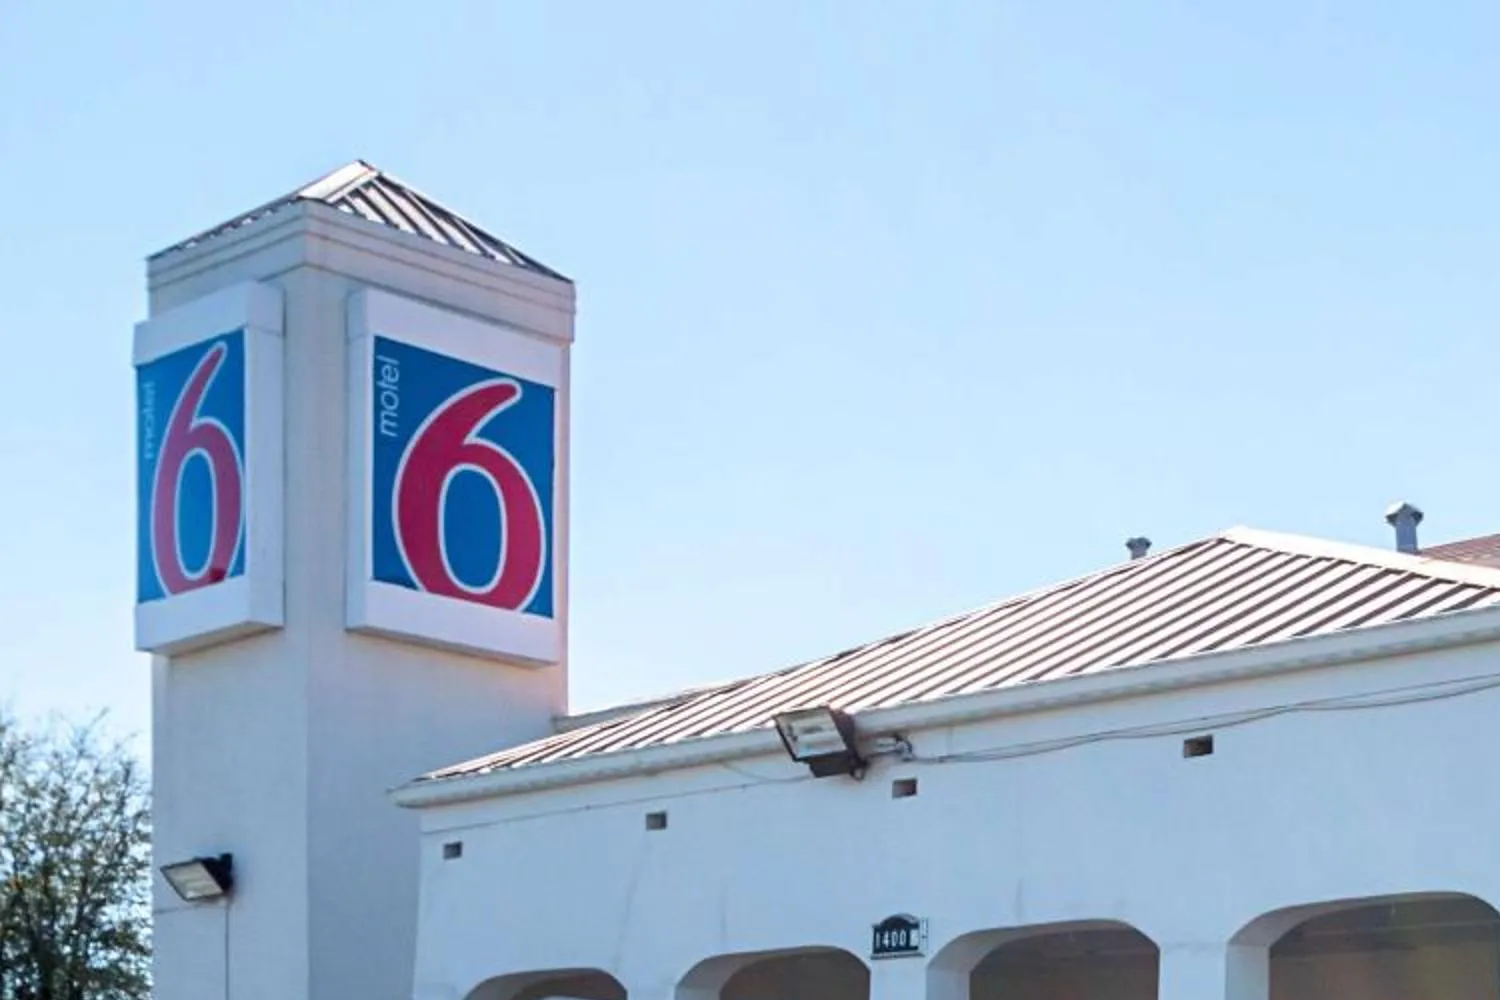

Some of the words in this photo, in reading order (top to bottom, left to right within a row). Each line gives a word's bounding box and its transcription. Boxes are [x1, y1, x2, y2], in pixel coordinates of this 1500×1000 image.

[151, 341, 243, 597] 6
[379, 354, 400, 438] motel
[392, 378, 546, 611] 6
